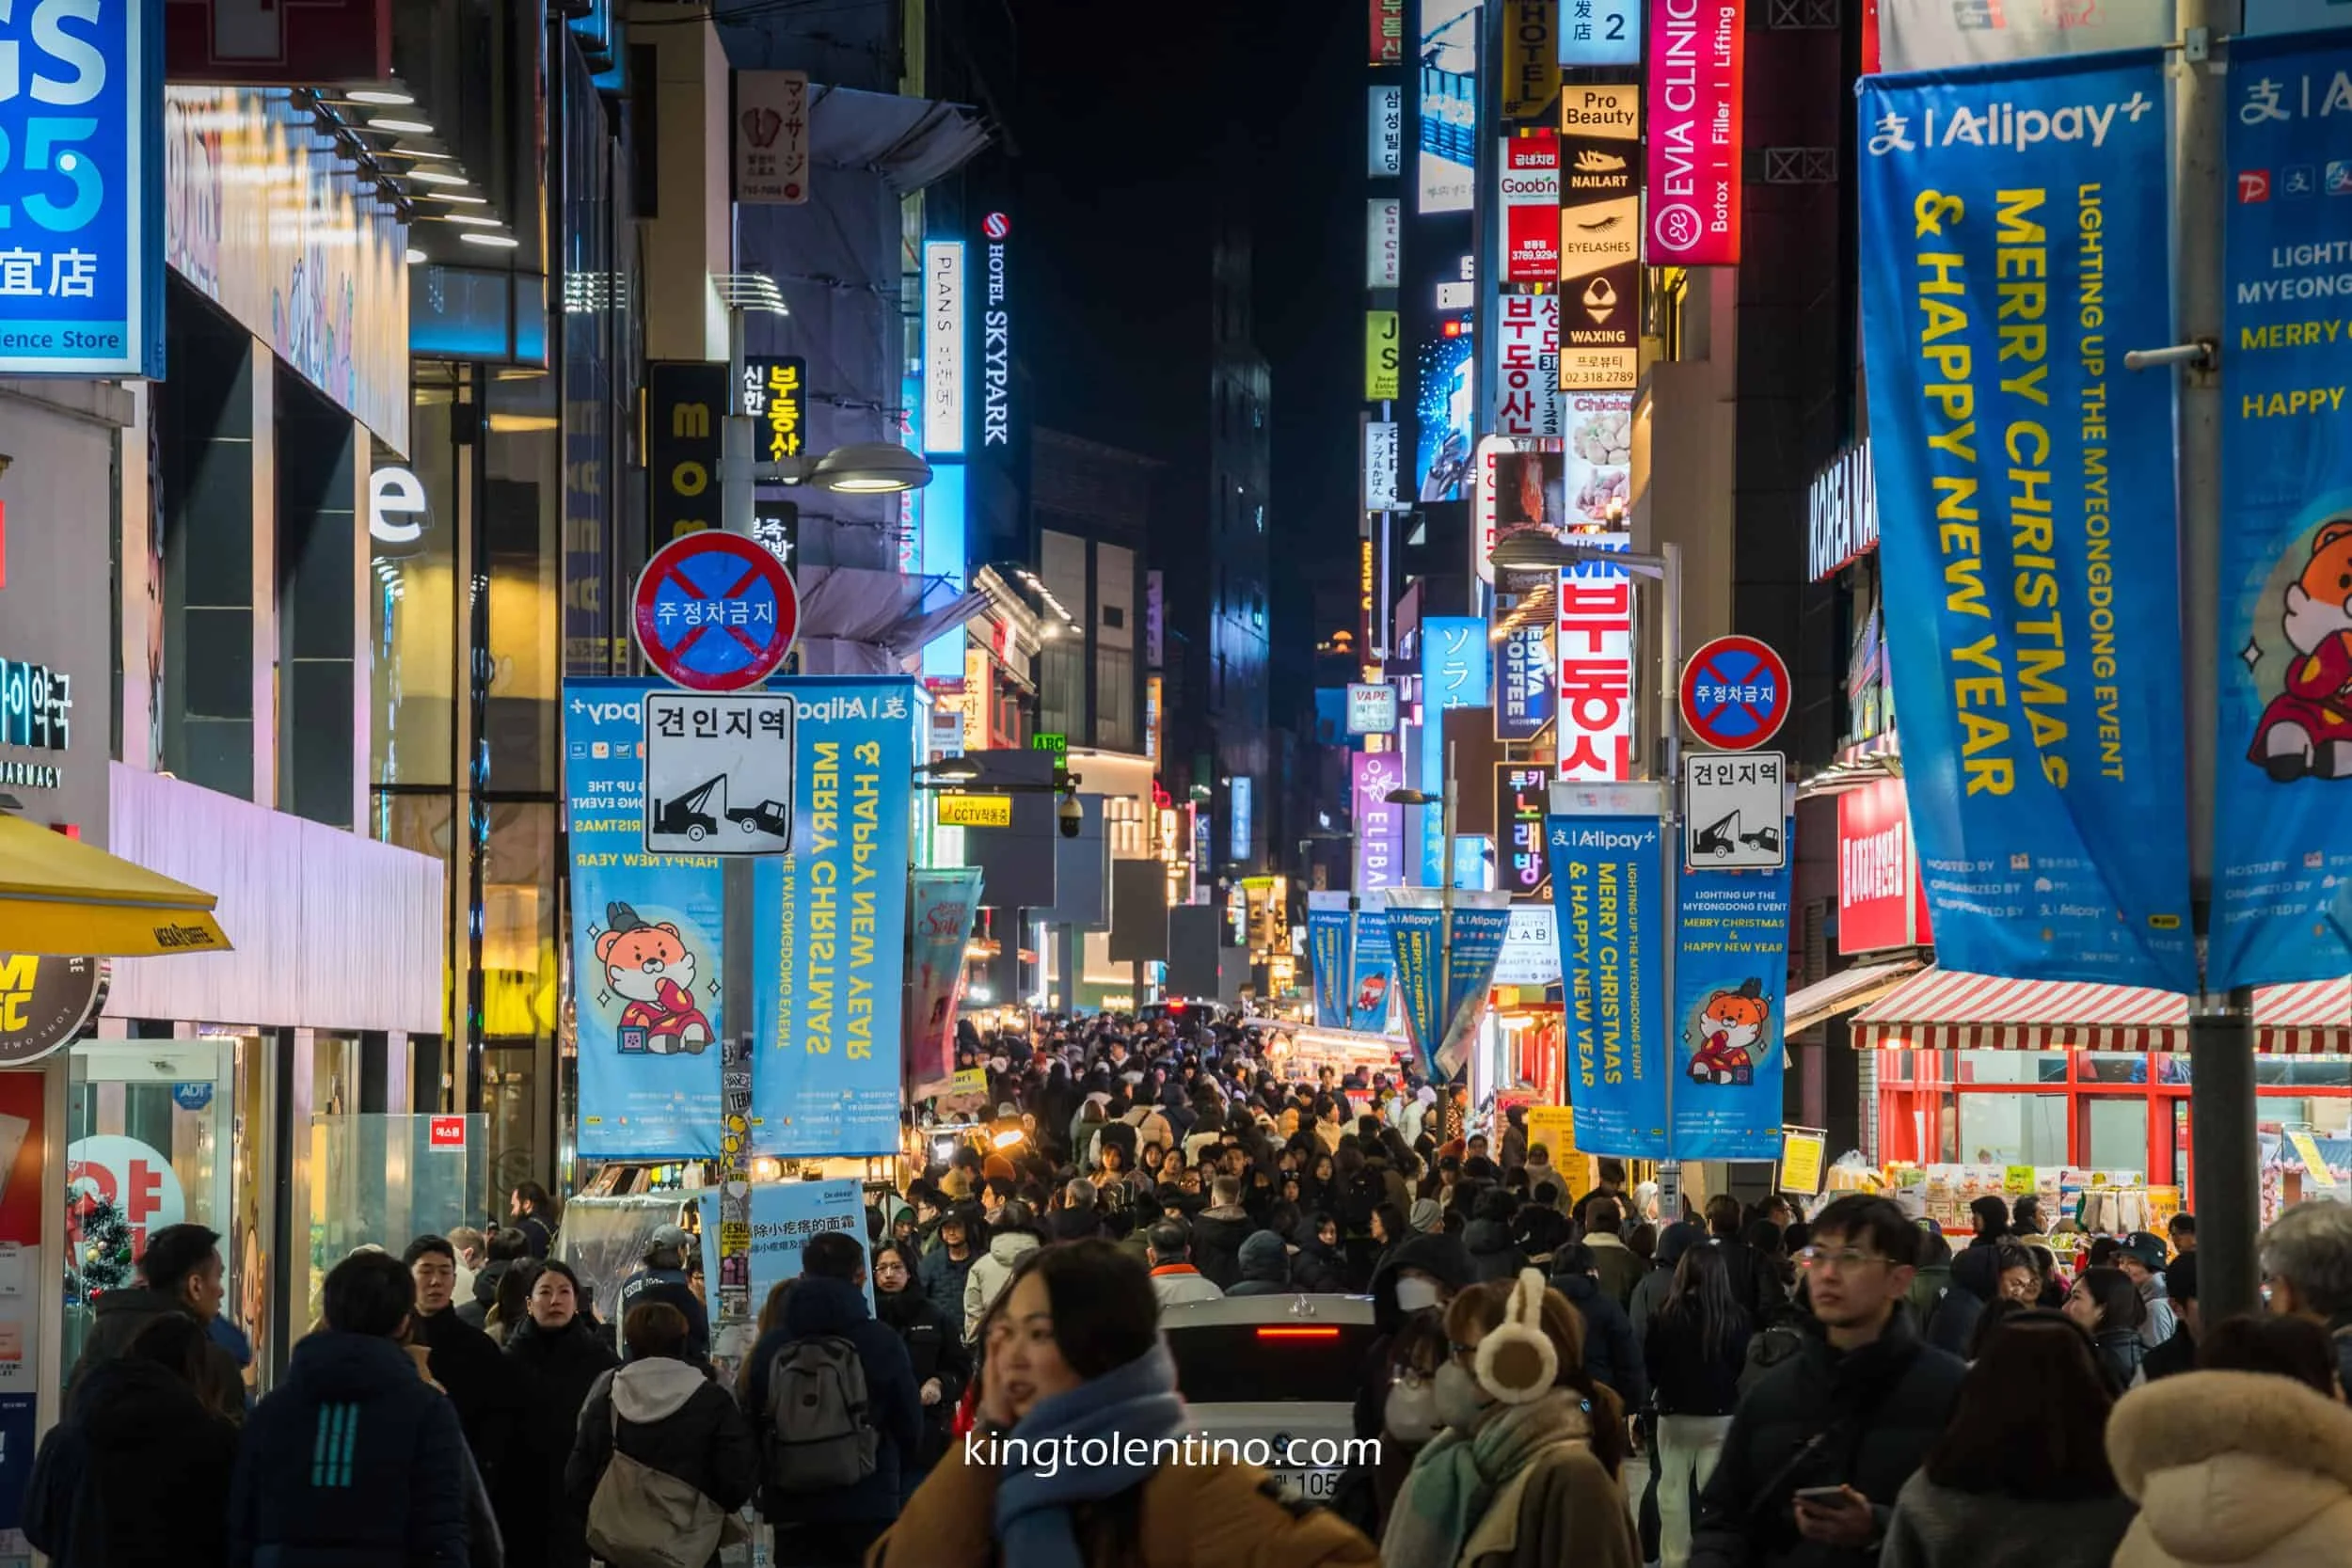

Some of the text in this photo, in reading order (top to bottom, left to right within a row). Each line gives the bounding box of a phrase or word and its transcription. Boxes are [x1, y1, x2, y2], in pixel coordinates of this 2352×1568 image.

[1605, 13, 1625, 40] 2
[0, 0, 106, 105] S
[1584, 91, 1617, 109] Pro
[784, 79, 804, 176] マッサージ
[1566, 108, 1634, 127] Beauty
[1711, 7, 1735, 232] Botox Filler Lifting
[0, 117, 103, 232] 5
[1664, 121, 1694, 196] EVIA
[1571, 175, 1629, 188] NAILART
[1568, 242, 1630, 253] EYELASHES
[0, 247, 98, 298] 宜店
[937, 256, 952, 332] PLANS
[1994, 188, 2049, 405] MERRY
[62, 330, 119, 349] Store
[984, 245, 1009, 447] HOTEL SKYPARK
[1570, 330, 1626, 342] WAXING
[2241, 319, 2341, 351] MERRY
[1500, 297, 1536, 434] 부동산
[1565, 372, 1634, 383] 02.318.2789
[1576, 356, 1623, 369] 프로뷰티
[743, 365, 766, 417] 신한
[2242, 387, 2345, 419] HAPPY
[768, 365, 800, 462] 부동산
[1914, 189, 2015, 798] & HAPPY NEW YEAR
[2077, 182, 2123, 783] LIGHTING UP THE MYEONGDONG EVENT
[1809, 453, 1851, 582] KOREA
[656, 599, 774, 626] 주정차금지
[2003, 420, 2070, 789] CHRISTMAS
[1507, 627, 1525, 716] COFFEE
[1562, 583, 1630, 782] 부동산
[1356, 691, 1389, 702] VAPE
[1696, 685, 1774, 705] 주정차금지
[657, 707, 785, 739] 견인지역
[1509, 770, 1545, 792] 루키
[1694, 762, 1779, 785] 견인지역
[1514, 793, 1544, 885] 노래방
[1683, 902, 1788, 912] MYEONGDONG EVENT
[1695, 891, 1776, 900] LIGHTING UP THE
[1508, 928, 1547, 941] LAB
[1684, 918, 1786, 928] MERRY CHRISTMAS
[1684, 942, 1783, 953] HAPPY NEW YEAR
[1569, 862, 1595, 1087] & HAPPY NEW YEAR
[1598, 863, 1622, 1085] MERRY CHRISTMAS
[1627, 863, 1643, 1080] LIGHTING UP THE MYEONGDONG EVENT
[180, 1083, 206, 1098] ADT
[722, 1223, 750, 1234] JESU
